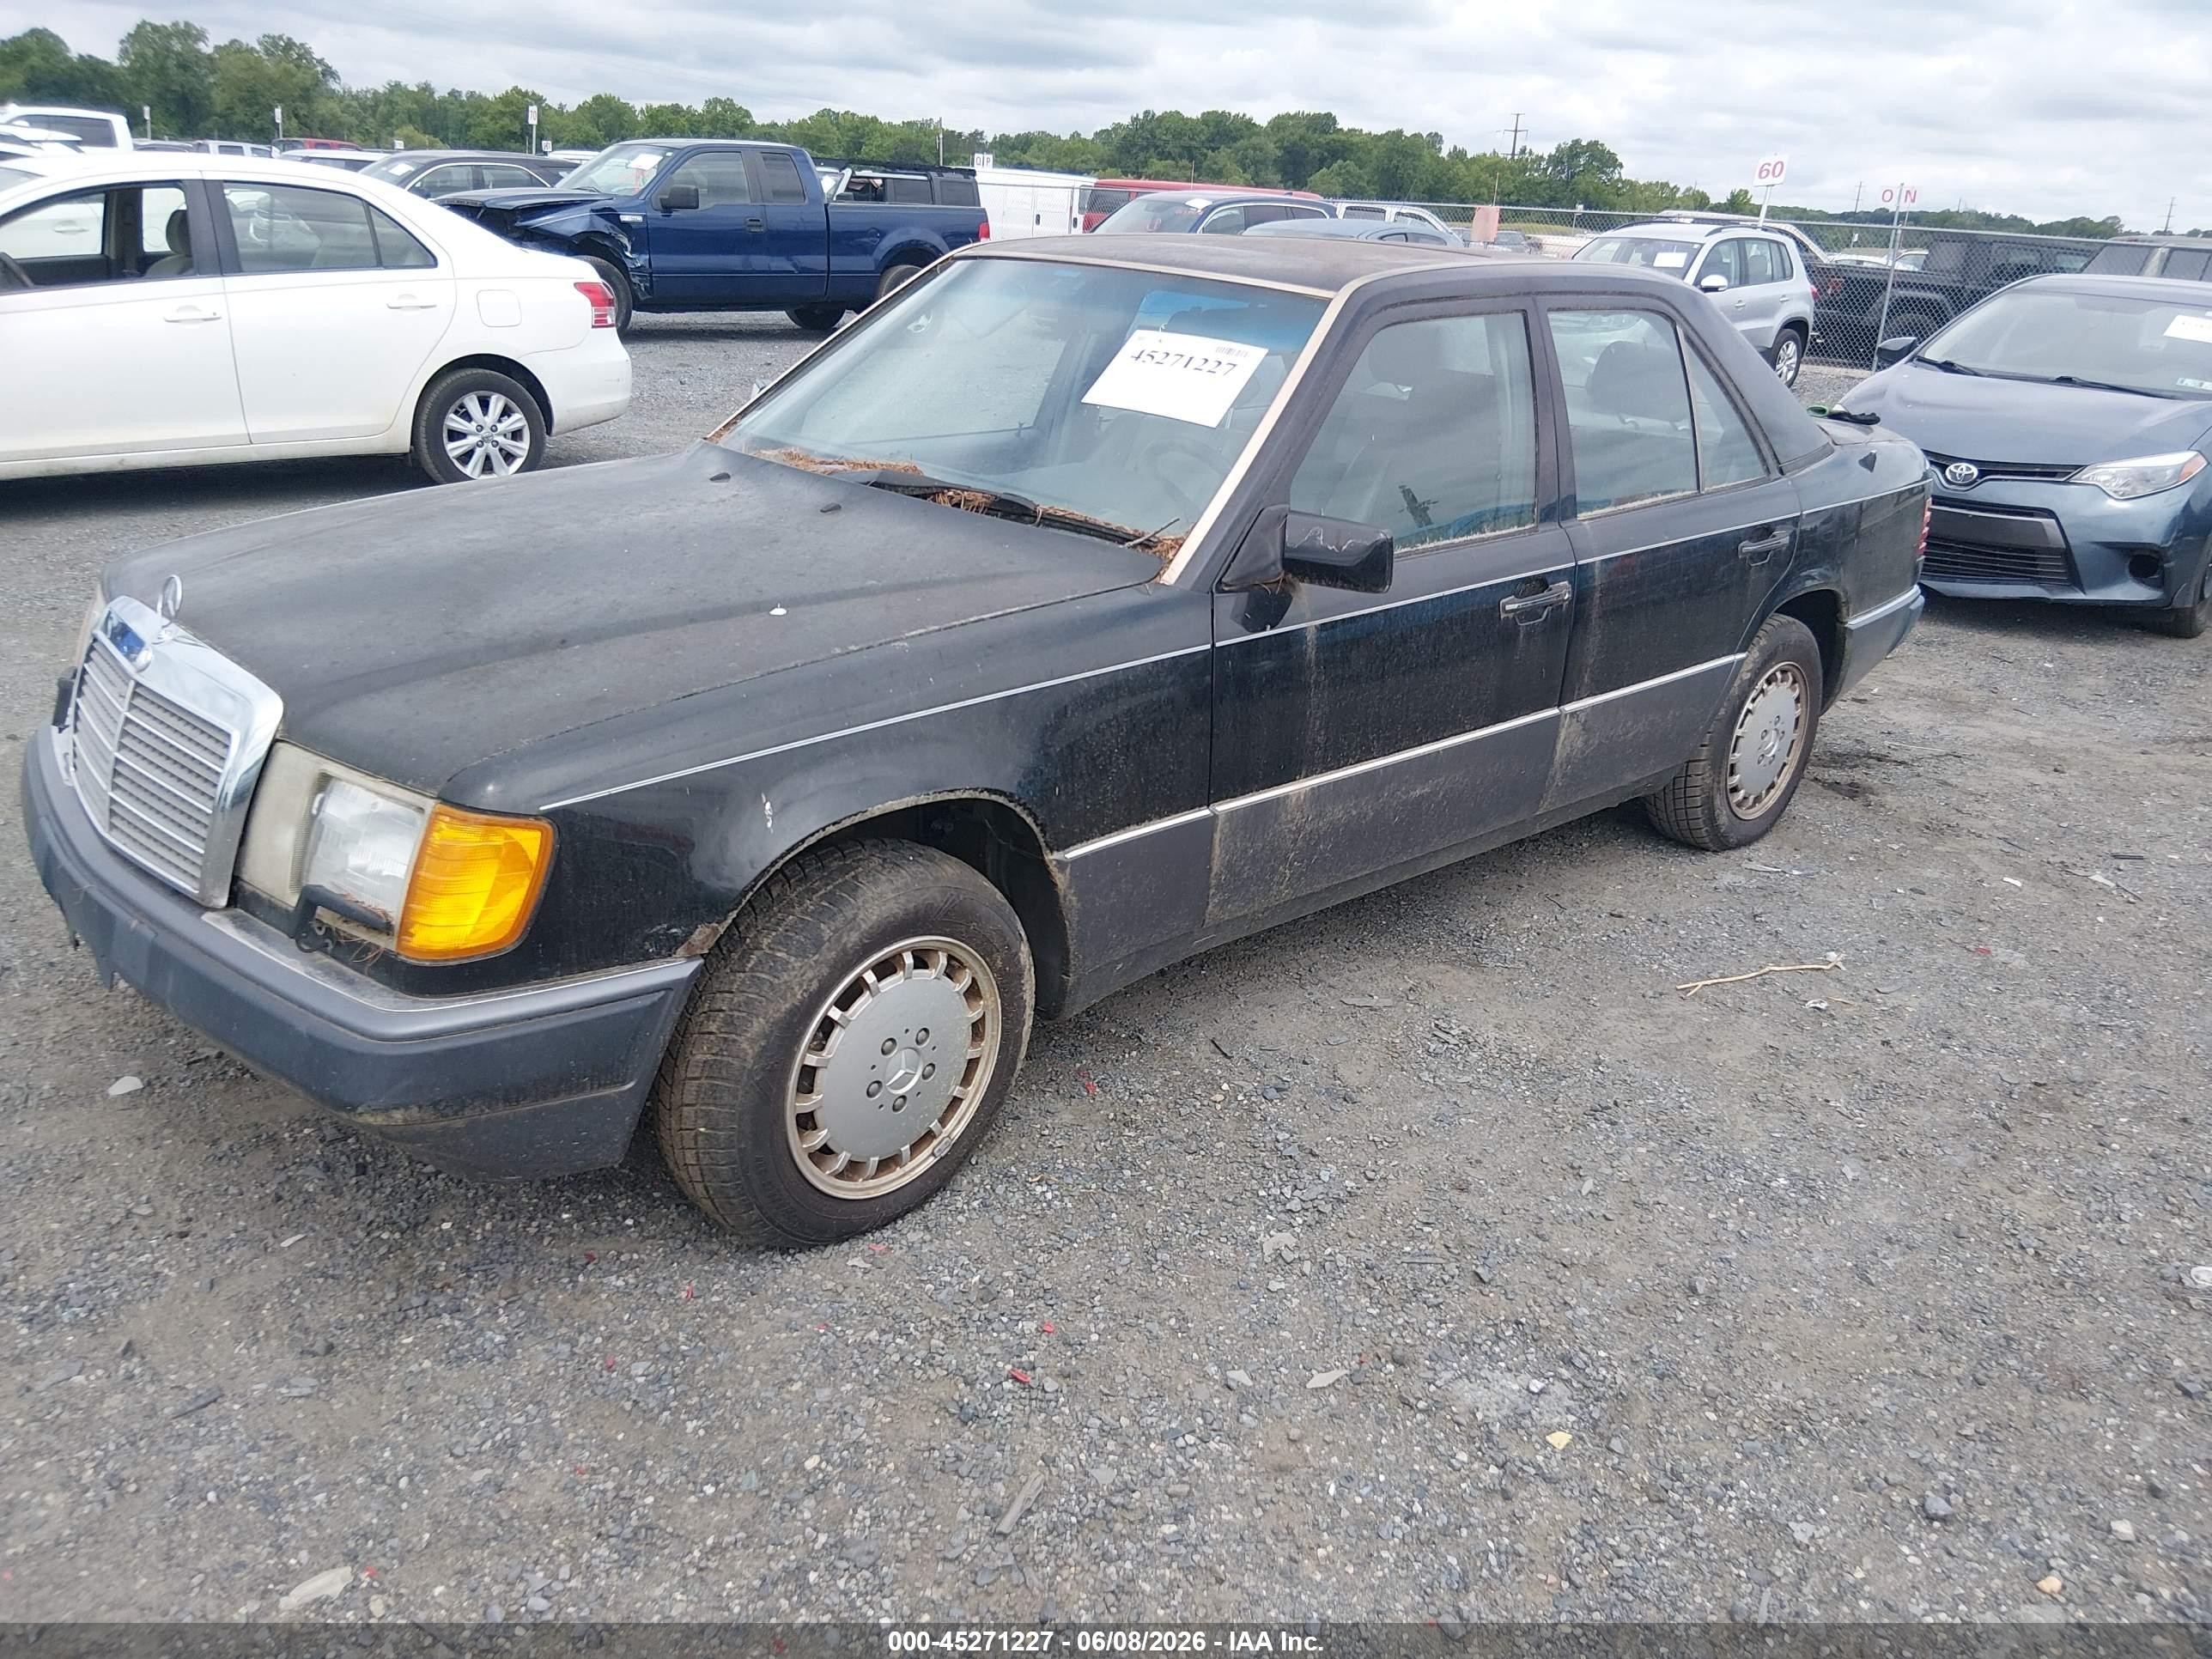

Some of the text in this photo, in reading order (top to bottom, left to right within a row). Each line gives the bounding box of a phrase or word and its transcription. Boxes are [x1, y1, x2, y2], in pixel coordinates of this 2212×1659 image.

[1758, 161, 1784, 179] 60
[1881, 189, 1893, 203] O
[1904, 190, 1917, 204] N
[1131, 349, 1237, 376] 45271227
